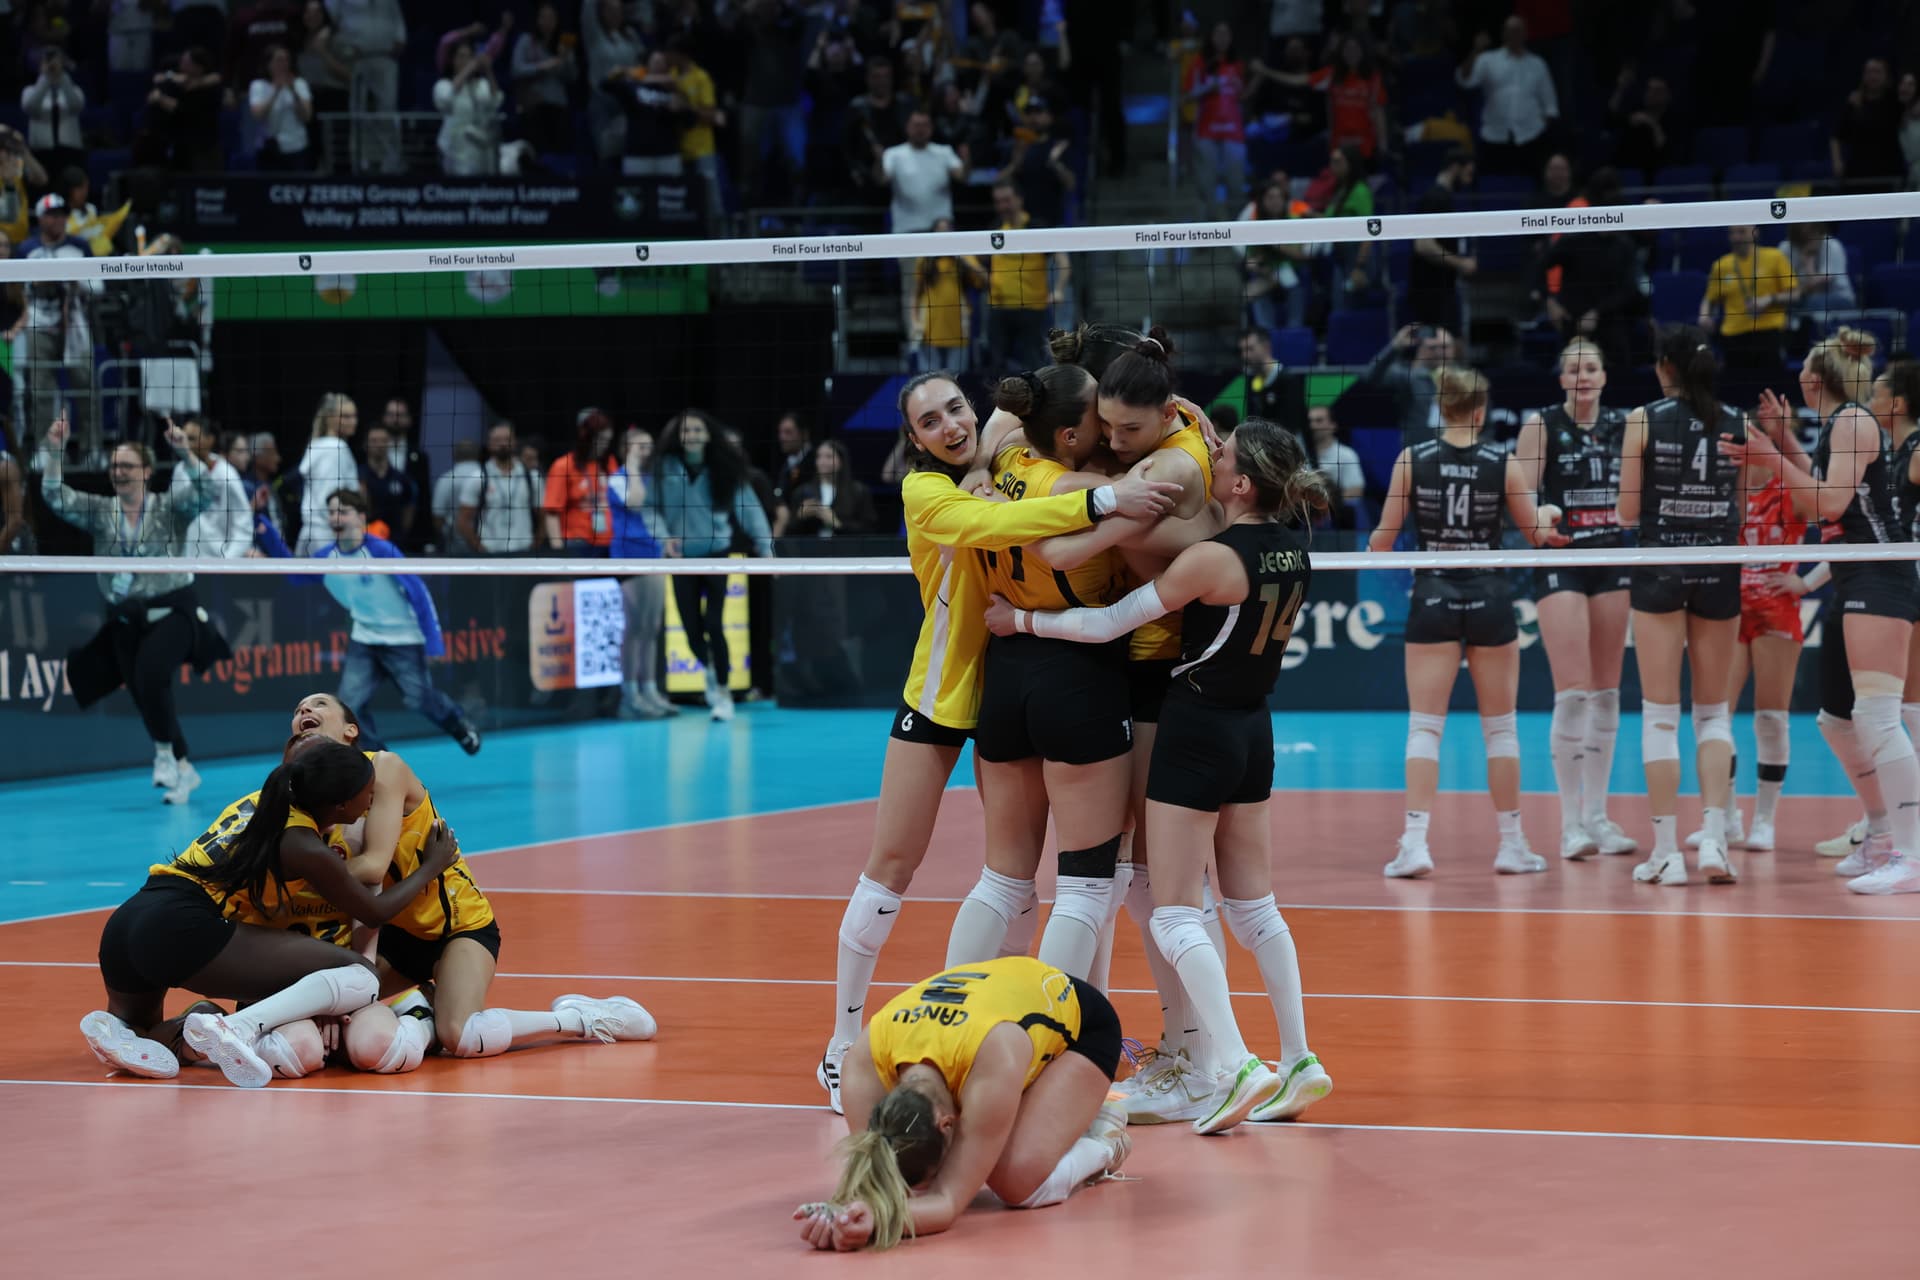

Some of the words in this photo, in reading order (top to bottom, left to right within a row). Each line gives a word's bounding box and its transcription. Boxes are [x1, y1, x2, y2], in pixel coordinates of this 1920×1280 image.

[366, 184, 419, 206] Group
[422, 184, 514, 206] Champions
[517, 185, 580, 205] League
[402, 208, 464, 225] Women
[467, 206, 508, 226] Final
[510, 206, 549, 225] Four
[1521, 215, 1548, 228] Final
[1551, 215, 1576, 227] Four
[1577, 212, 1625, 225] Istanbul
[1135, 231, 1161, 243] Final
[1163, 230, 1187, 242] Four
[1188, 228, 1232, 240] Istanbul
[772, 243, 797, 255] Final
[798, 243, 821, 254] Four
[822, 241, 864, 253] Istanbul
[100, 262, 124, 274] Final
[124, 262, 146, 273] Four
[146, 260, 185, 273] Istanbul
[429, 254, 452, 266] Final
[454, 254, 475, 265] Four
[476, 252, 516, 264] Istanbul
[1690, 437, 1708, 482] 4
[1446, 482, 1471, 527] 14
[1249, 580, 1304, 656] 14
[901, 711, 914, 732] 6
[892, 1004, 969, 1027] CANSU
